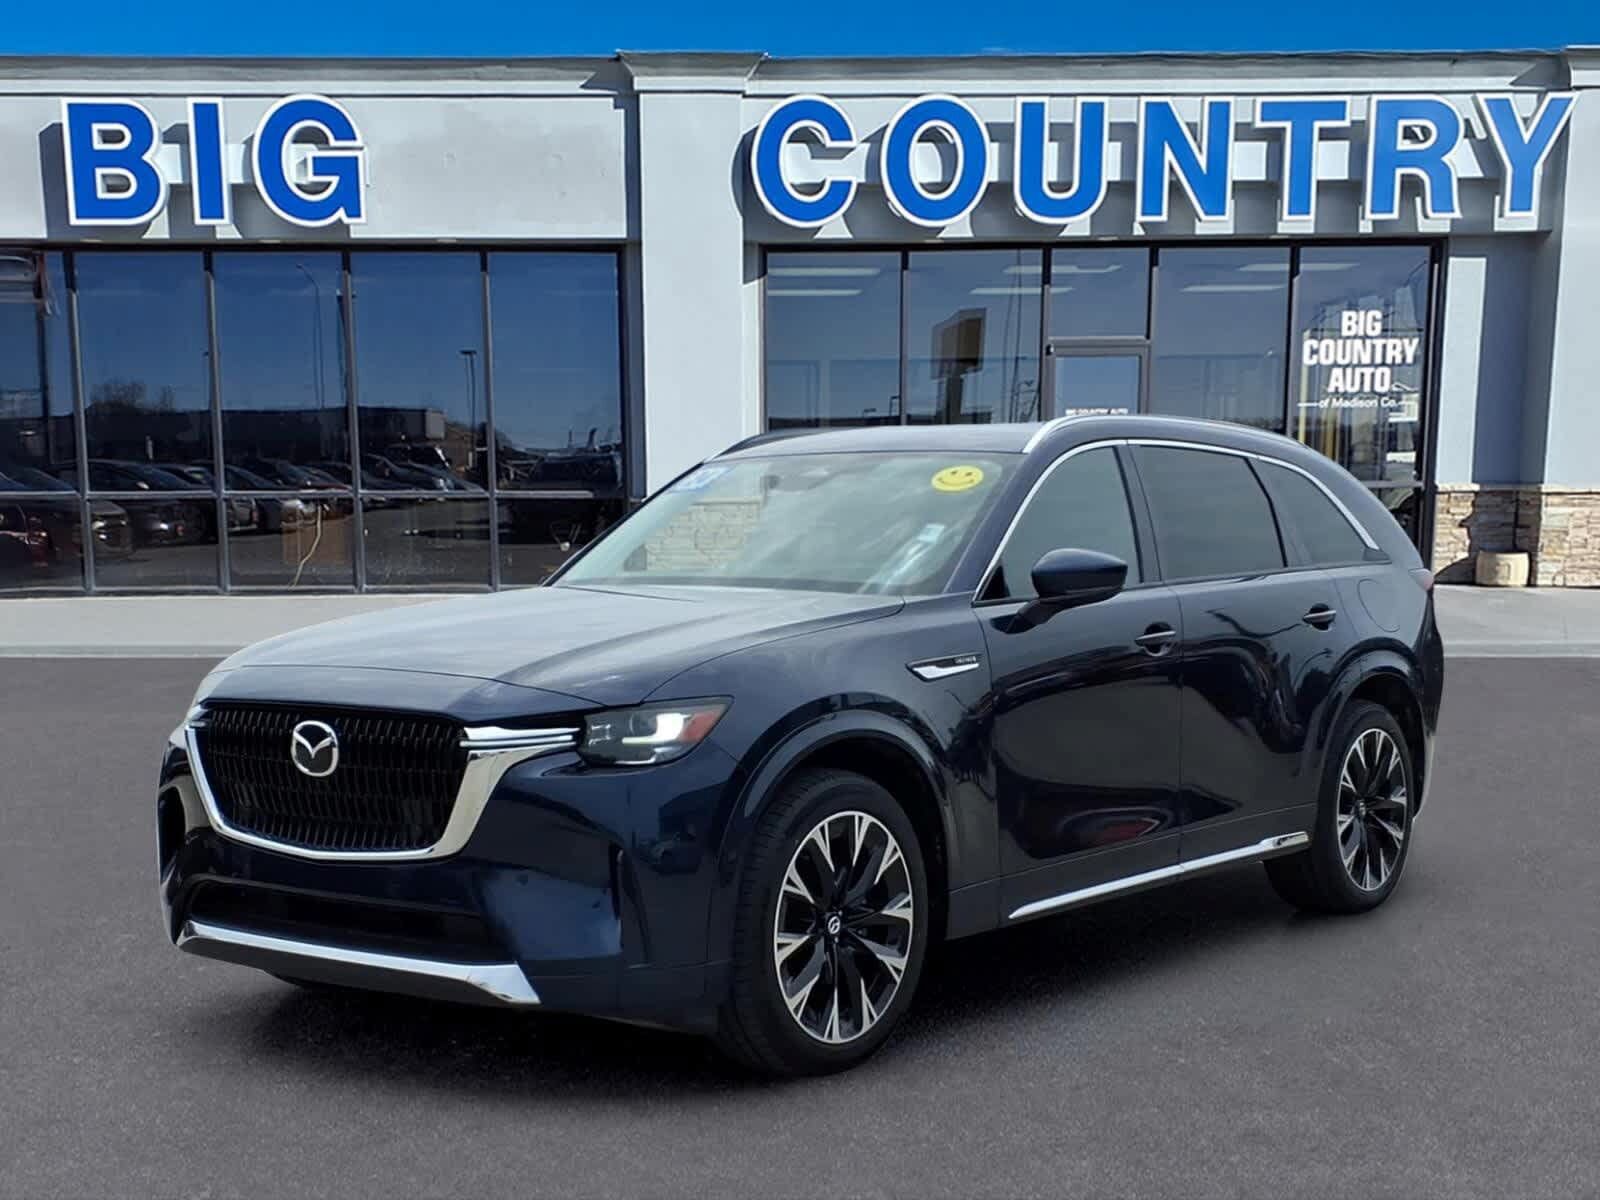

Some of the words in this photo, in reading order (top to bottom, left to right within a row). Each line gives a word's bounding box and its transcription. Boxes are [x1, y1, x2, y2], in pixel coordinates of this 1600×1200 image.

[61, 94, 367, 228] BIG
[751, 92, 1580, 228] COUNTRY
[1340, 309, 1383, 337] BIG
[1302, 337, 1420, 367] COUNTRY
[1327, 366, 1392, 394] AUTO
[1330, 397, 1378, 409] Madison
